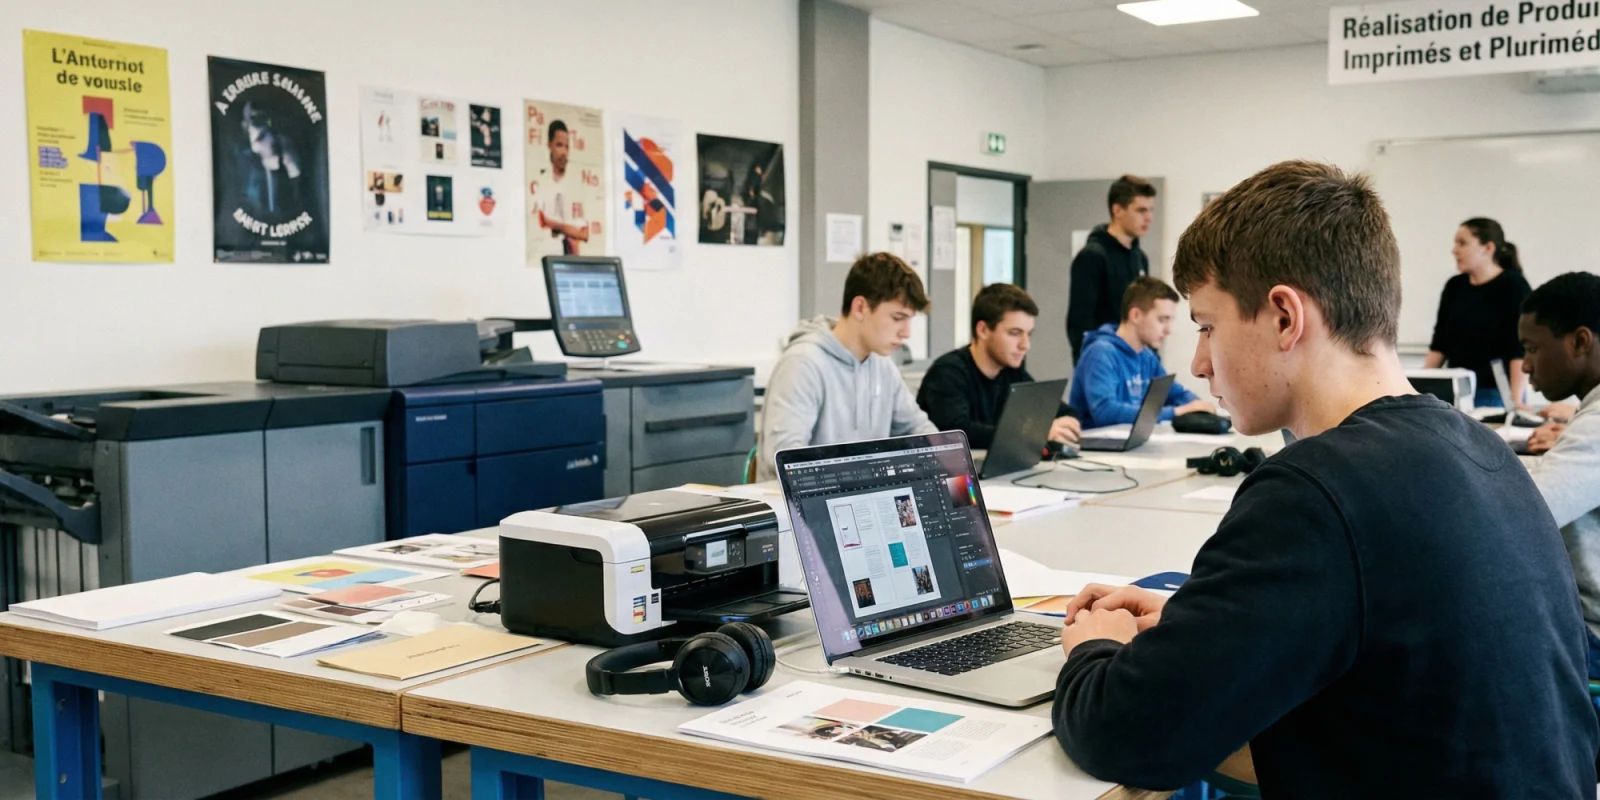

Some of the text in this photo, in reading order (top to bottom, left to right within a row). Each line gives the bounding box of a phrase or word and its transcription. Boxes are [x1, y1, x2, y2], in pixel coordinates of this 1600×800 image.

[1343, 10, 1472, 39] Réalisation
[1481, 5, 1509, 27] de
[1344, 42, 1451, 73] Imprimés
[1459, 41, 1481, 61] et
[57, 69, 79, 85] de
